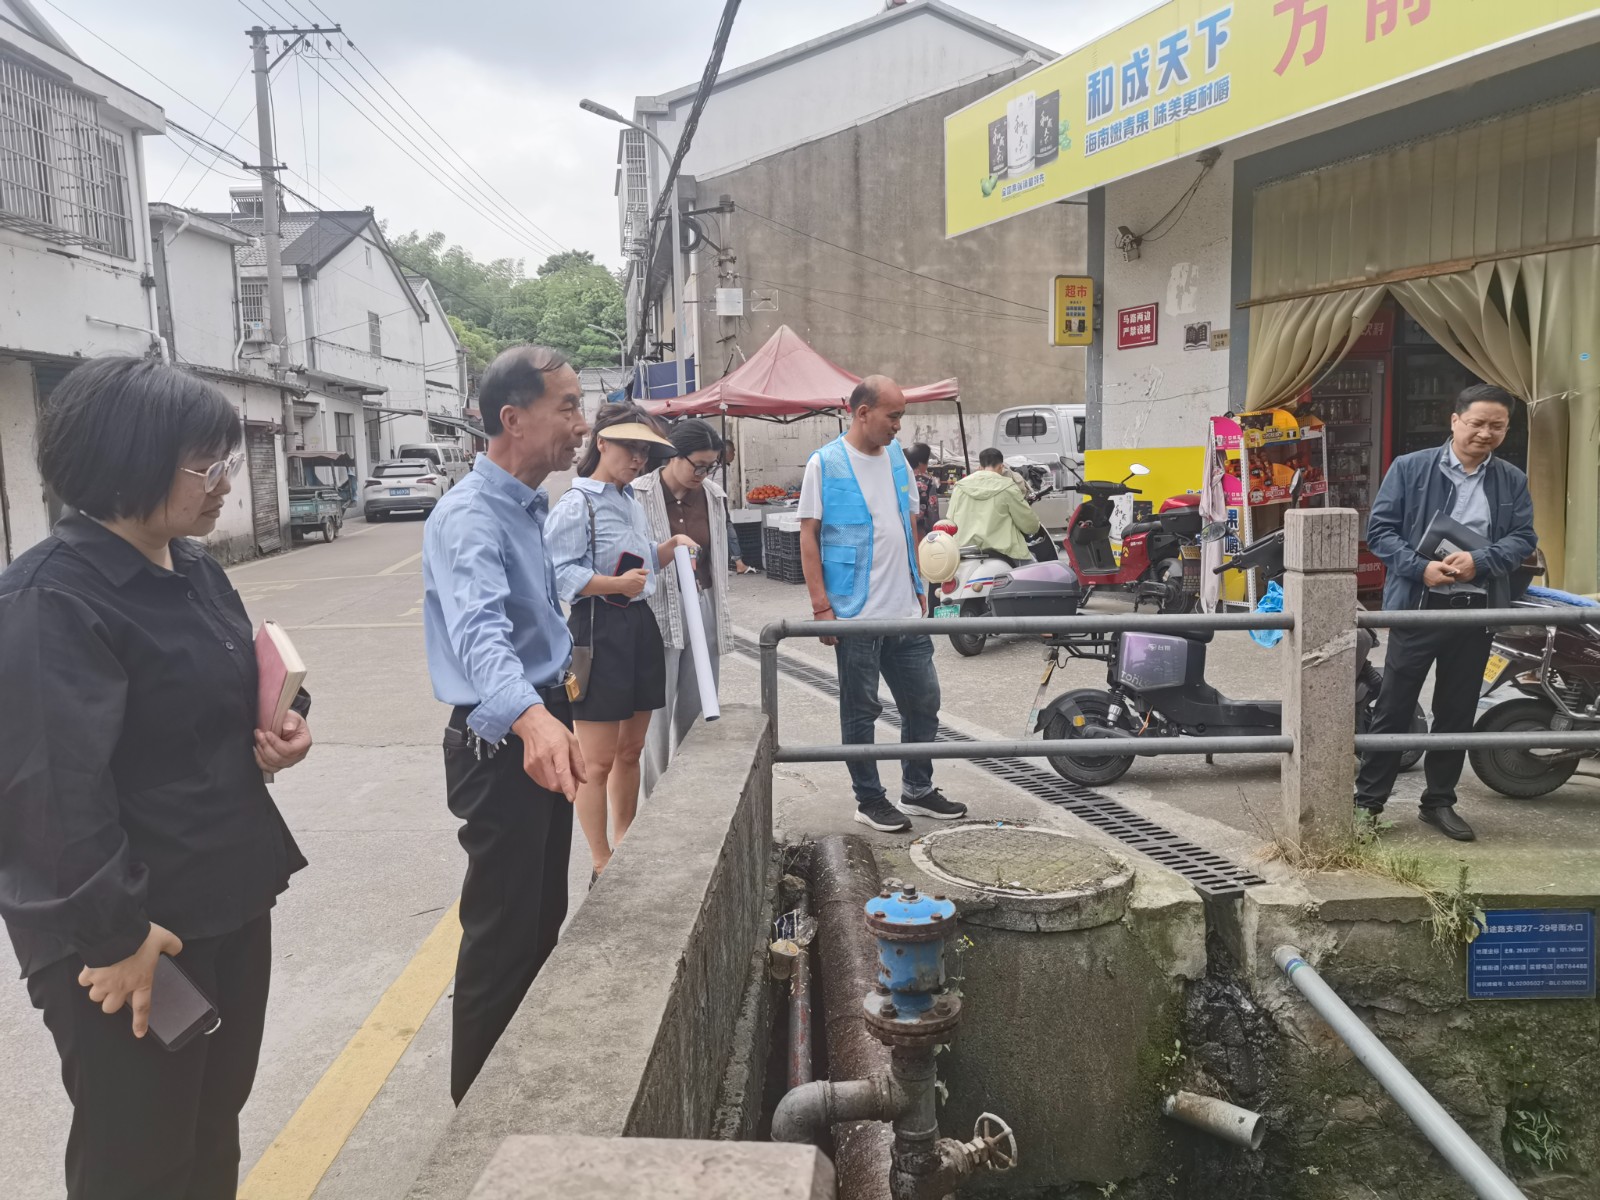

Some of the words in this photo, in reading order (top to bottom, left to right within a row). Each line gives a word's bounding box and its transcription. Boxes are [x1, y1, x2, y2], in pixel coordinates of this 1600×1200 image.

[1088, 7, 1231, 121] 和成天下
[1085, 109, 1149, 154] 海南嫩青果
[1154, 75, 1230, 126] 味美更耐嚼
[1065, 285, 1087, 298] 超市
[1123, 311, 1151, 324] 马路两边
[1122, 324, 1151, 338] 严禁设摊
